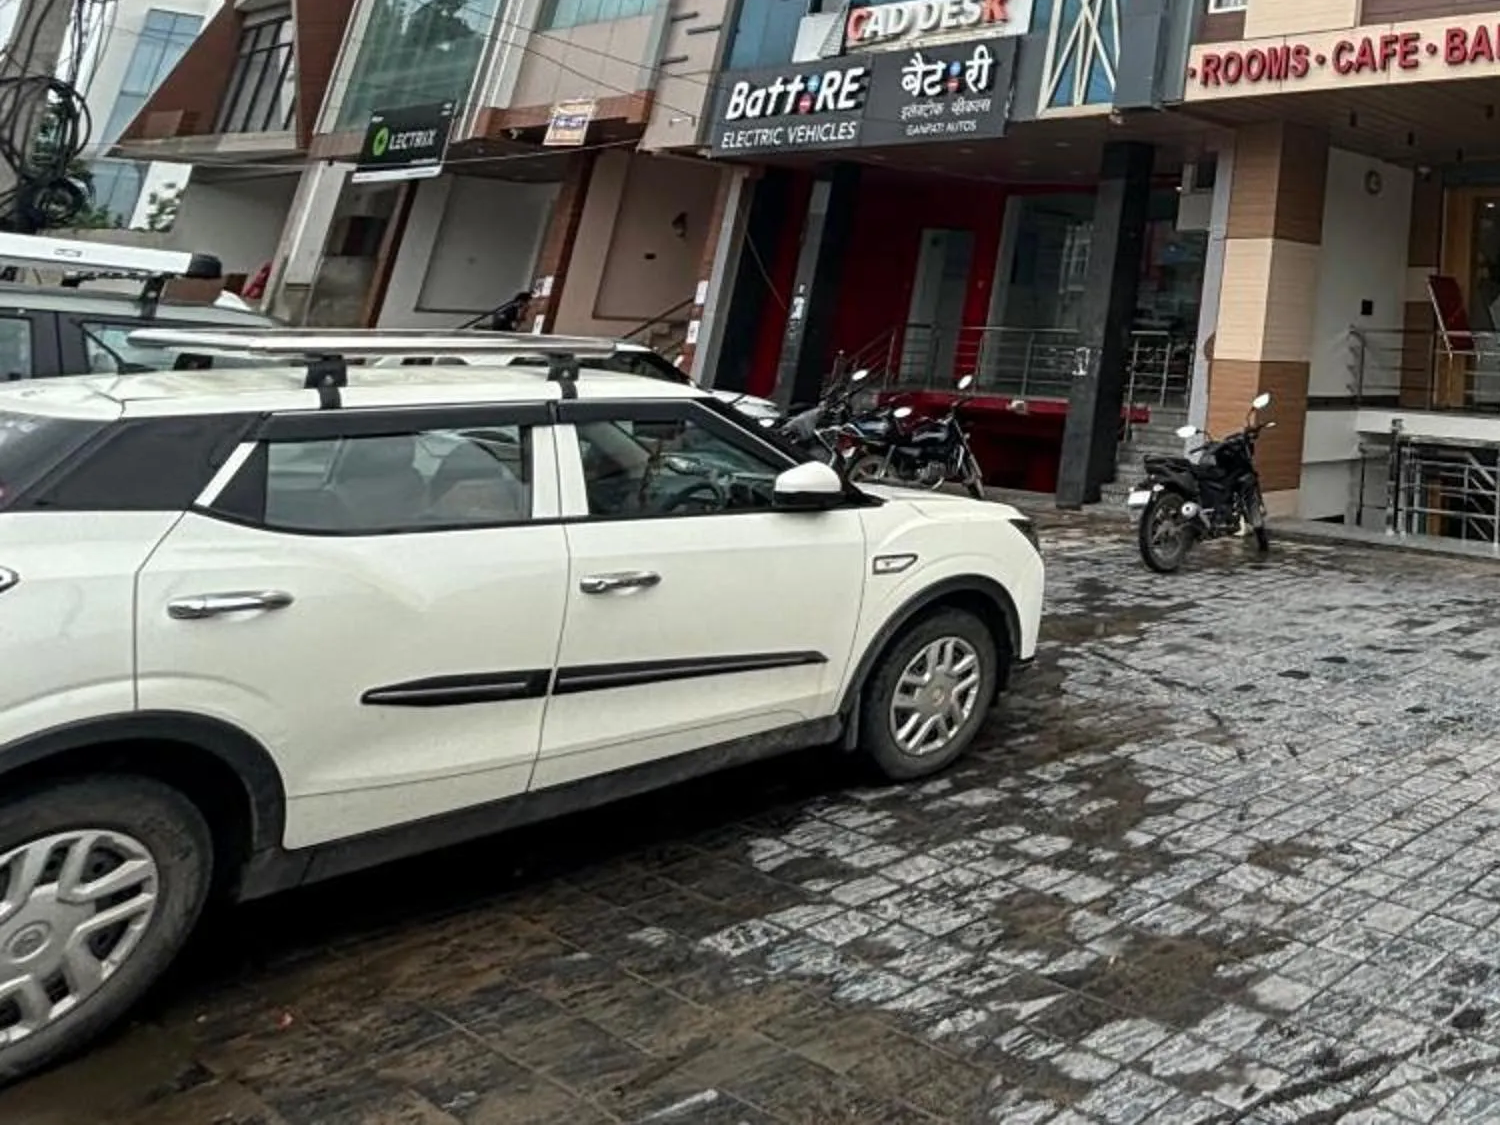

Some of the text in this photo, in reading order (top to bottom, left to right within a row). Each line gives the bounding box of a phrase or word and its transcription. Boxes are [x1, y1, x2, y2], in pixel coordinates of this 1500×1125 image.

[846, 2, 911, 42] CAD
[1201, 43, 1309, 87] ROOMS
[1332, 31, 1420, 75] CAFE
[721, 120, 858, 149] ELECTRIC VEHICLES
[946, 120, 977, 133] AUTOS
